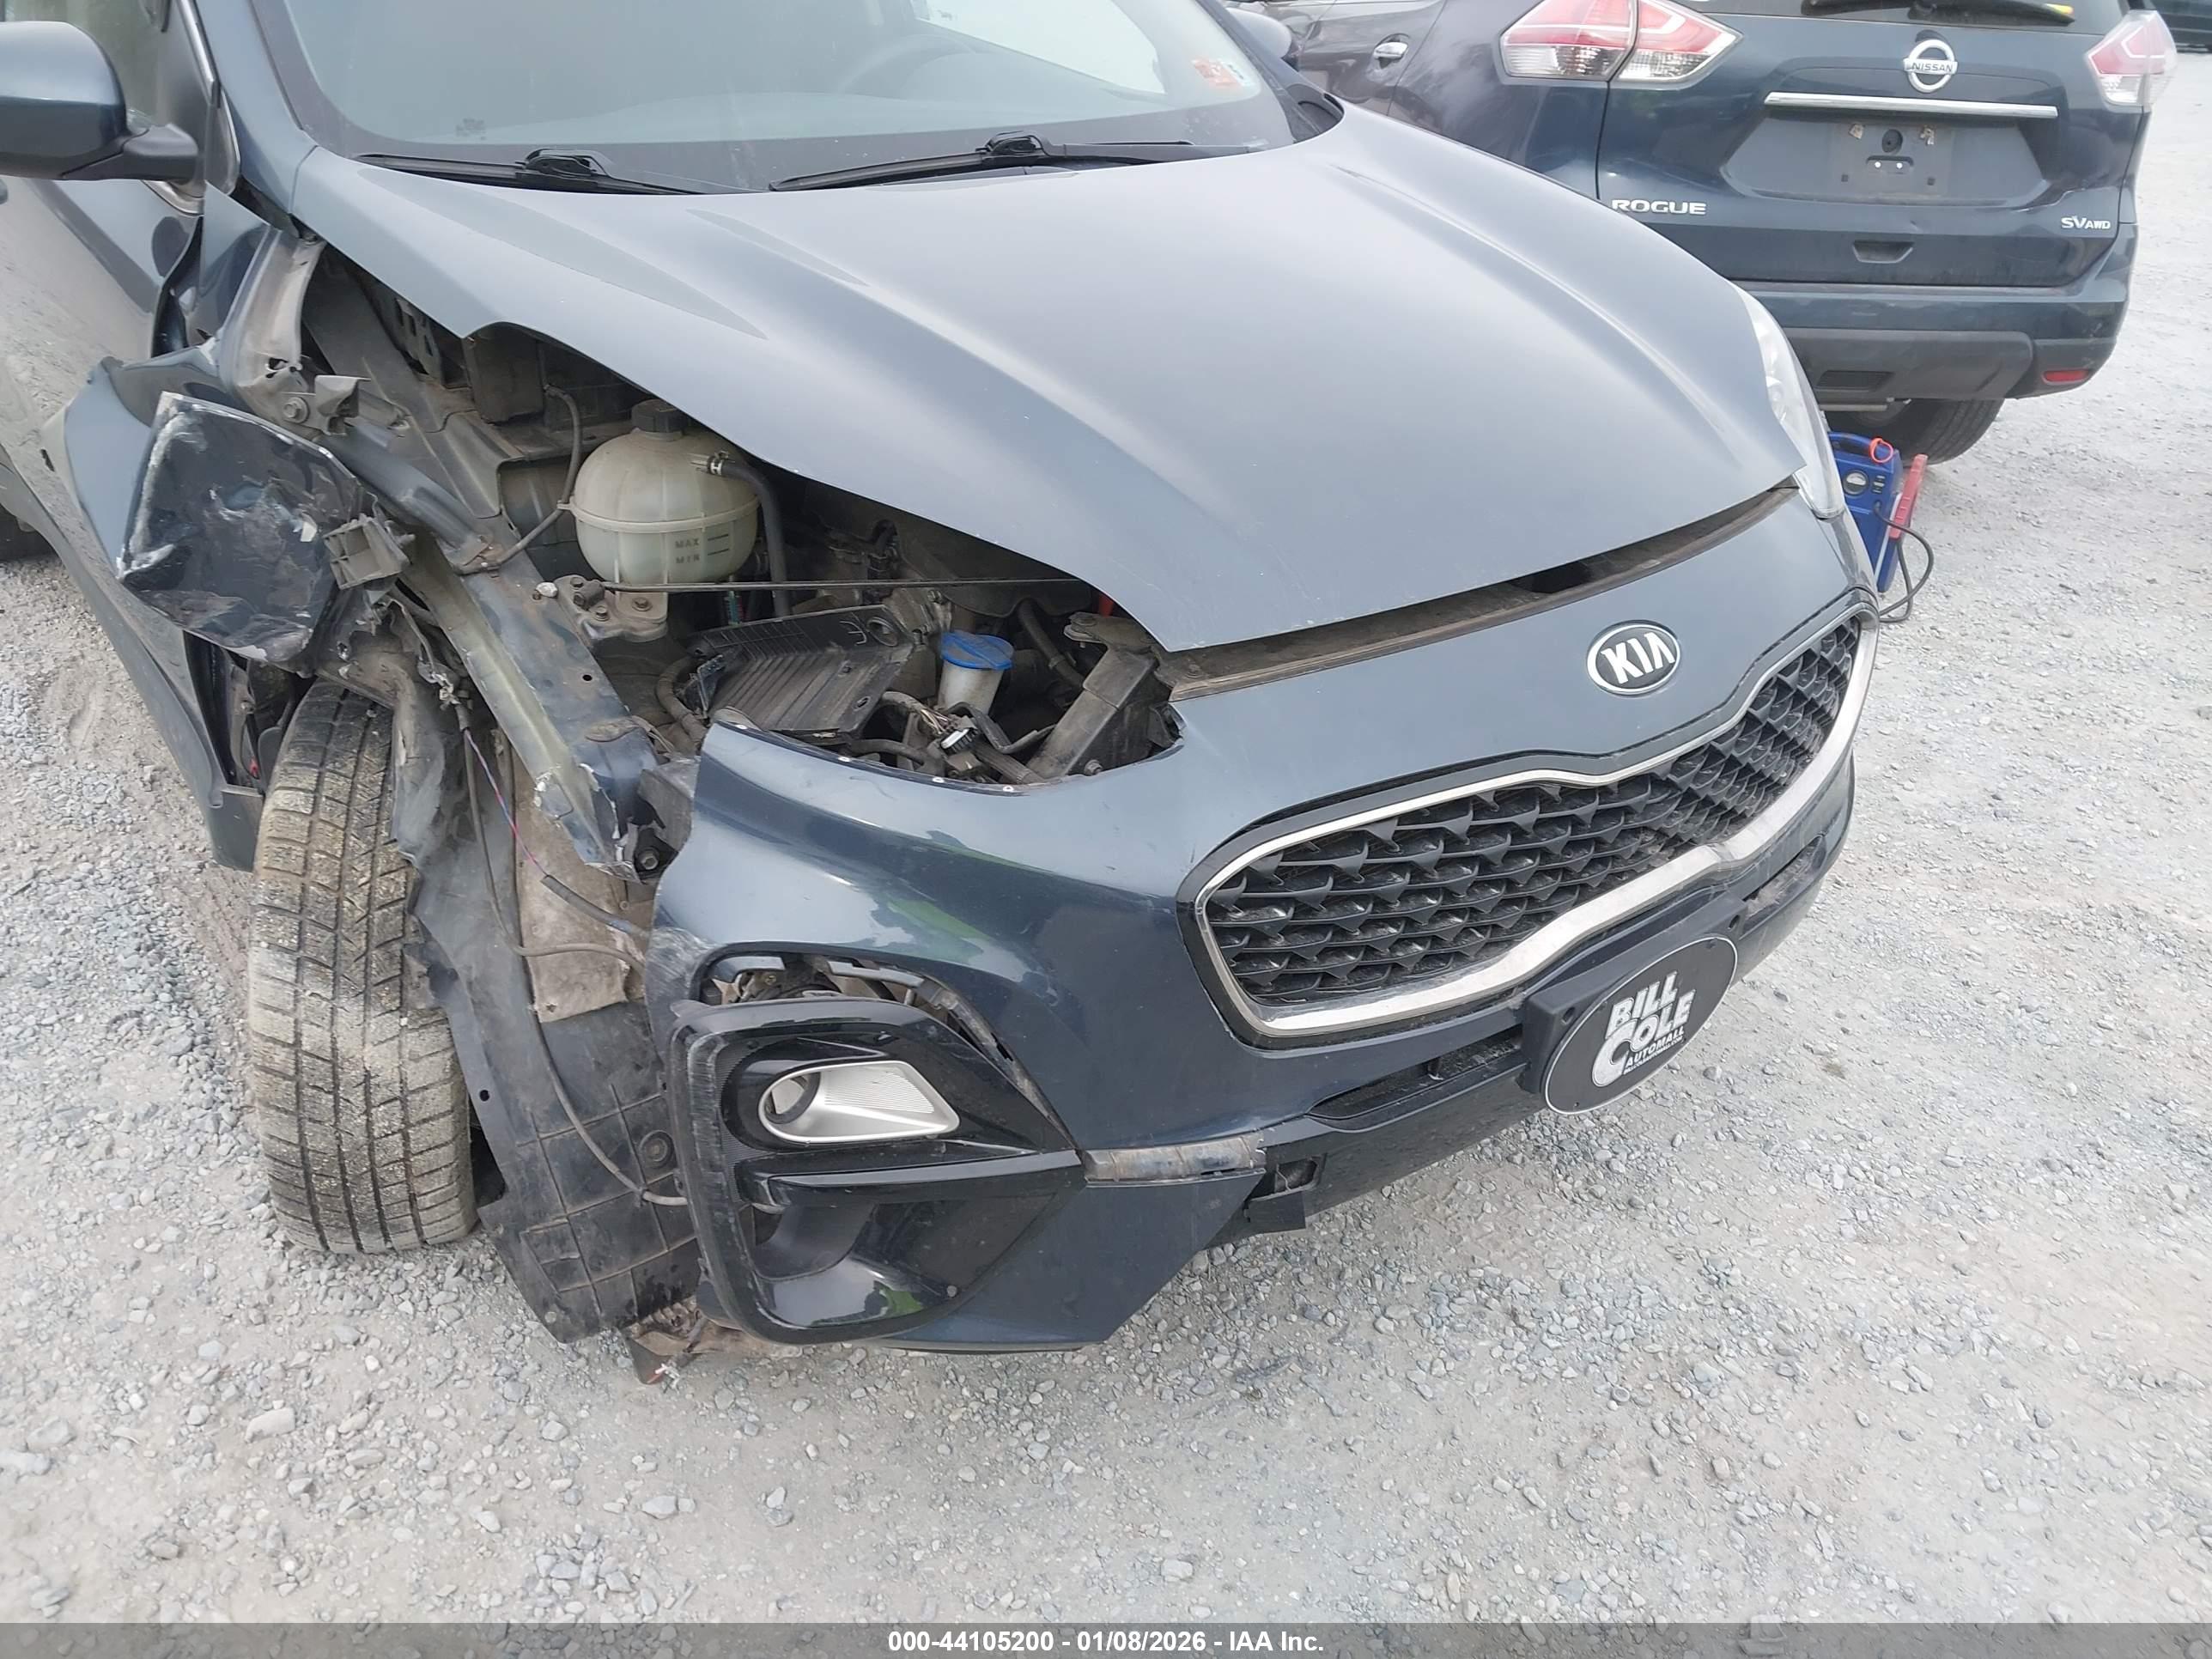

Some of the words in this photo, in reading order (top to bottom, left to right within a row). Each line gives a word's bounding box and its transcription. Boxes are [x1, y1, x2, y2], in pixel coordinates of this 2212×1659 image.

[1911, 62, 1954, 73] NISSAN
[1611, 199, 1707, 216] ROGUE
[675, 538, 700, 549] MAX
[675, 554, 700, 564] MIN
[1600, 631, 1676, 684] KIA
[1605, 970, 1678, 1041] BILL
[1592, 988, 1697, 1088] COLE
[1625, 1025, 1685, 1069] AUTOMALL
